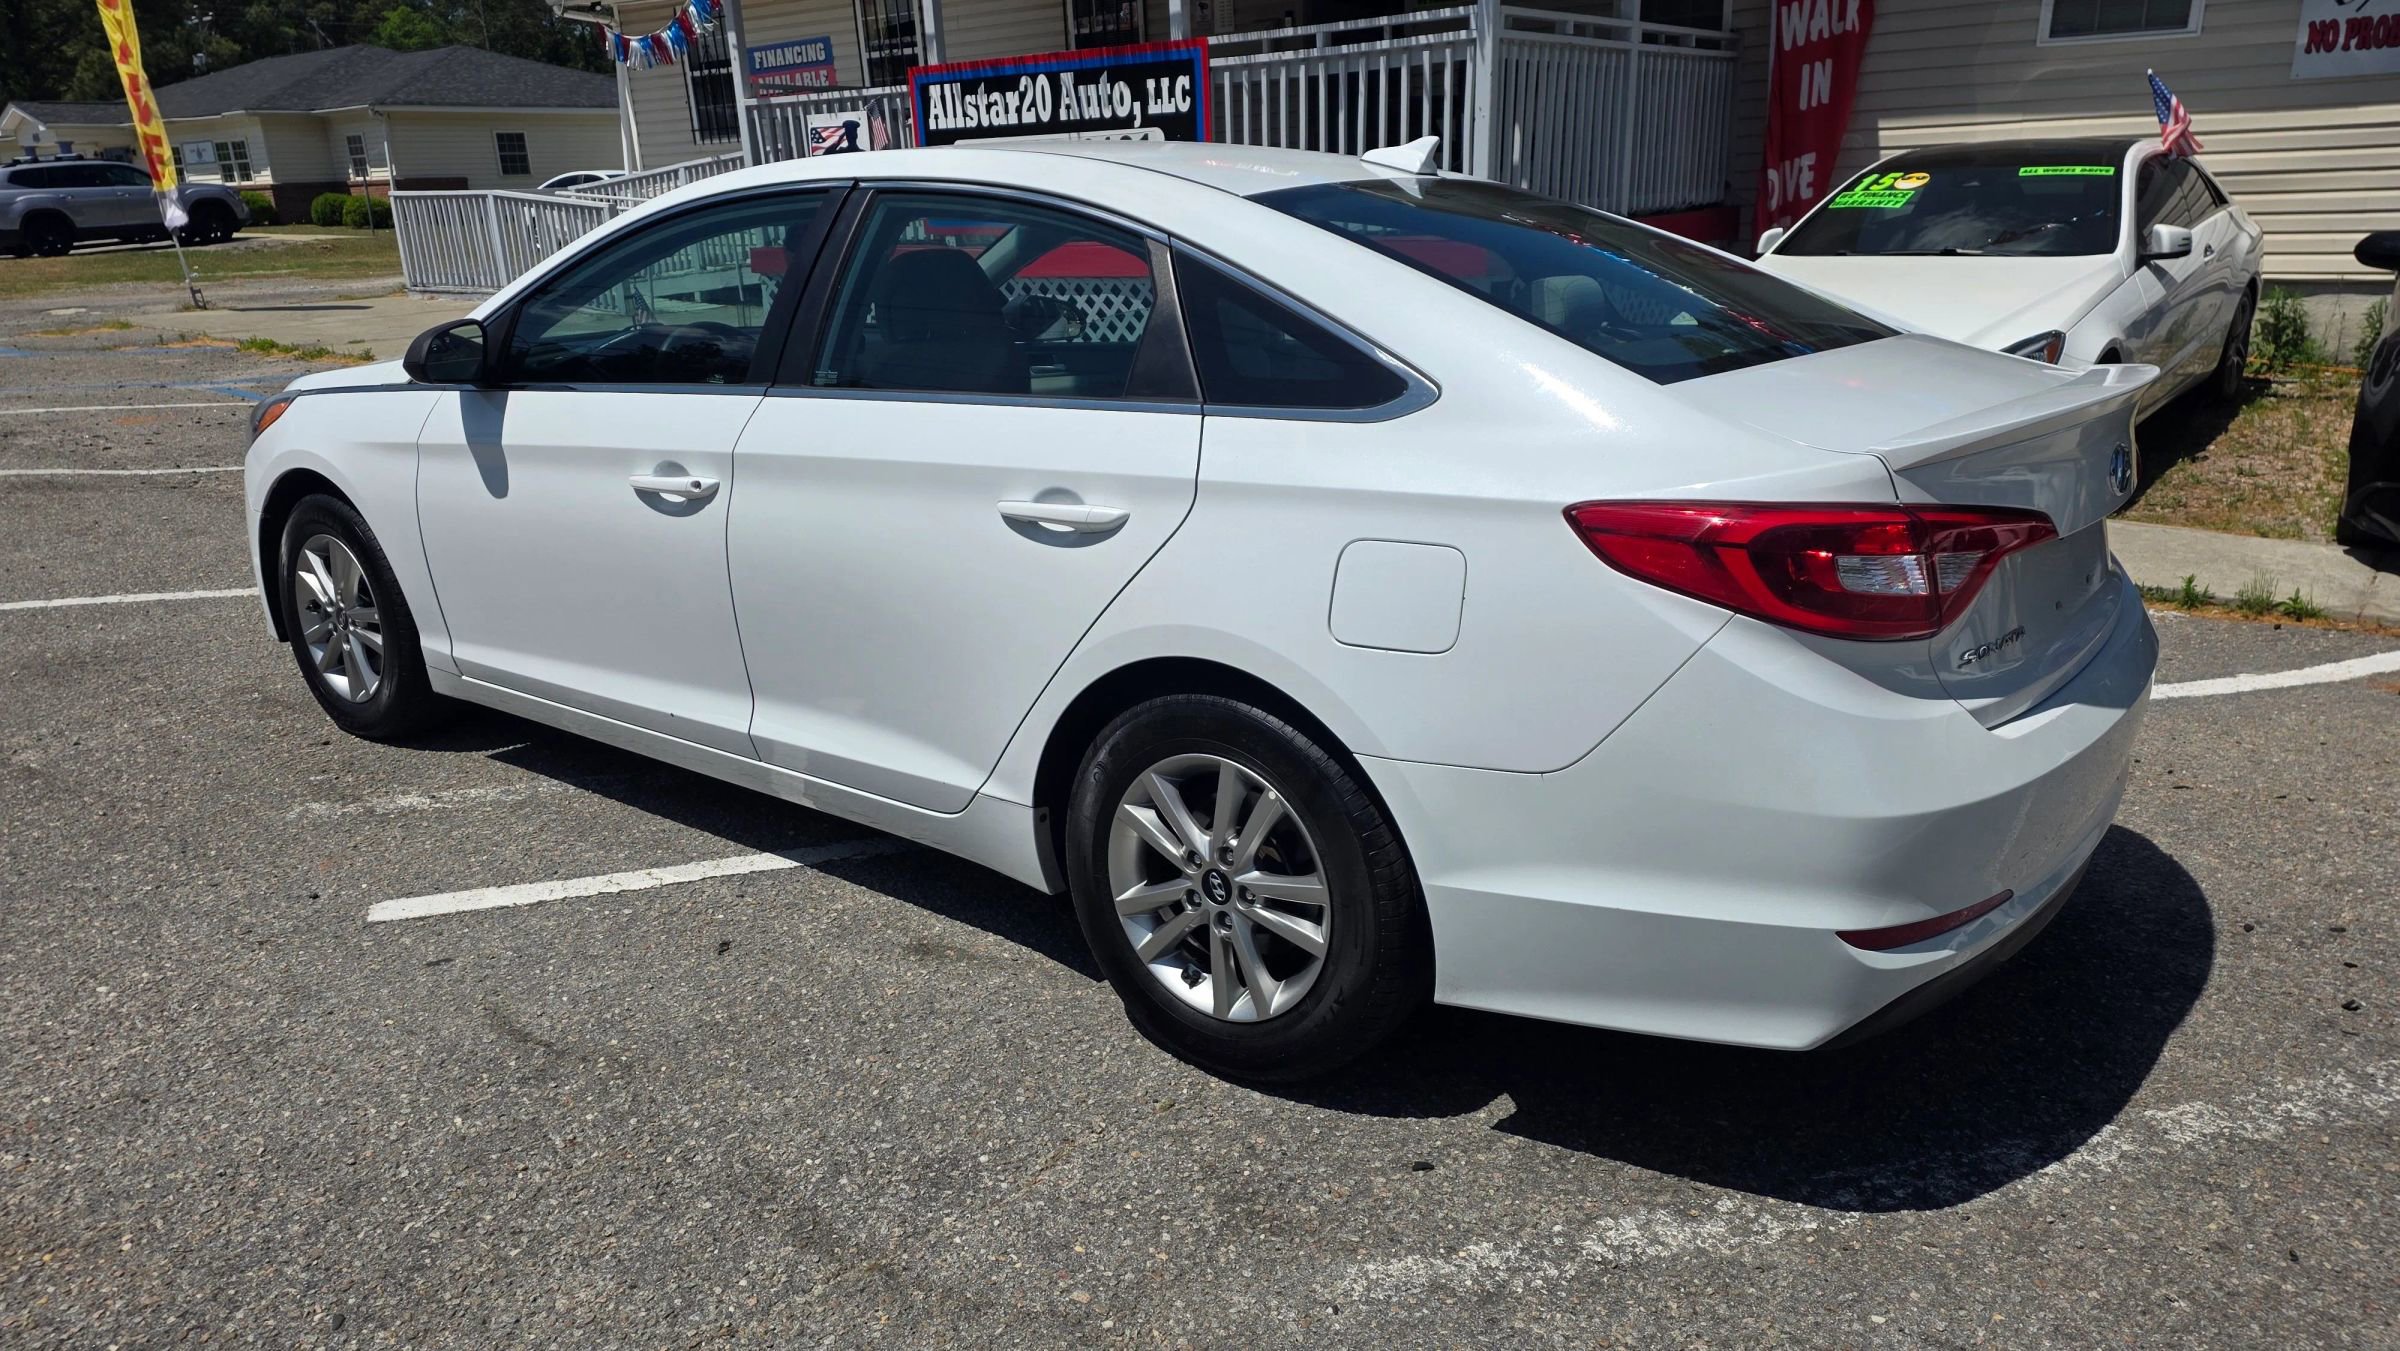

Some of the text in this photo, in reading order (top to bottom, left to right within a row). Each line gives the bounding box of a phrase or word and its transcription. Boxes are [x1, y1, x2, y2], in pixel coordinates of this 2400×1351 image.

[1781, 0, 1860, 51] WALK
[2304, 18, 2340, 54] NO
[753, 42, 826, 69] FINANCING
[928, 69, 1191, 130] Allstar20 Auto, LLC
[1799, 58, 1833, 111] IN
[1854, 172, 1904, 193] 15
[1957, 625, 2026, 669] SONATA
